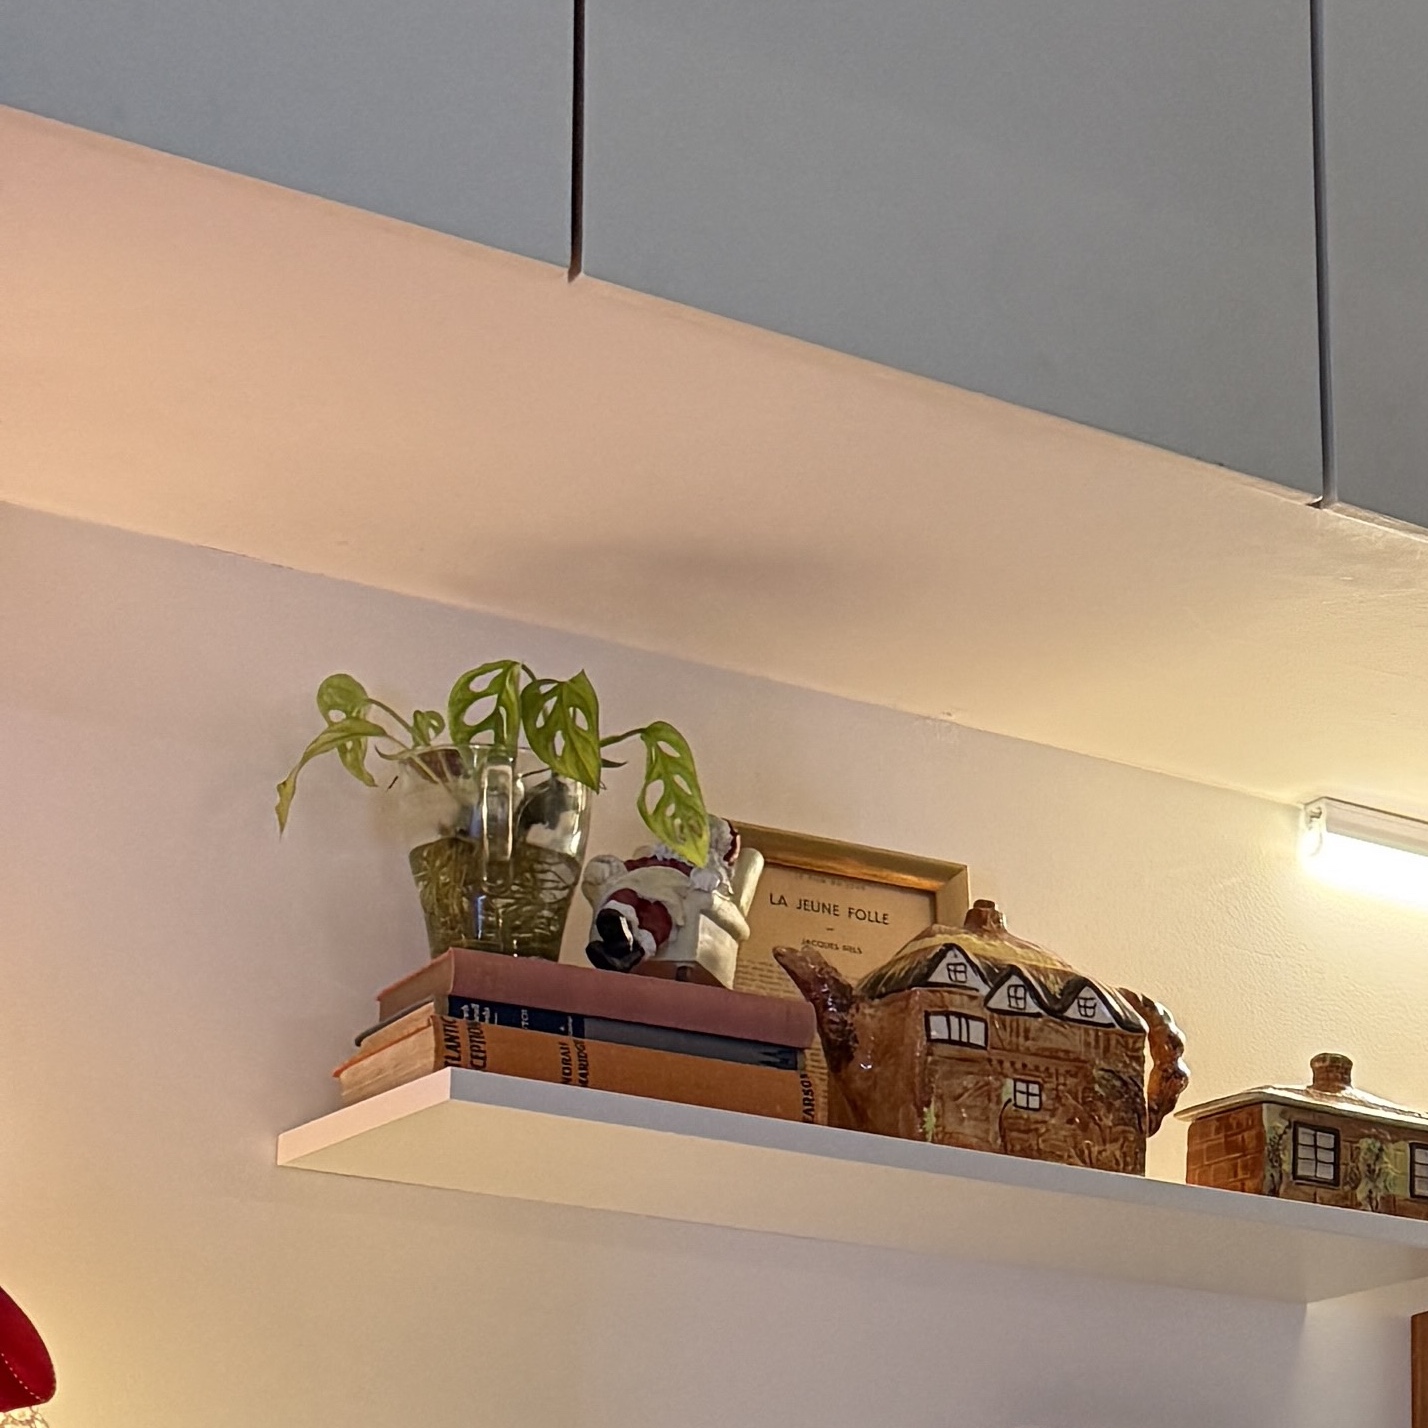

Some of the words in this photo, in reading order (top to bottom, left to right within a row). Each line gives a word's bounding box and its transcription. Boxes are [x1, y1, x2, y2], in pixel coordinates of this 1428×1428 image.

[770, 893, 789, 908] LA
[796, 898, 840, 917] JEUNE
[848, 907, 890, 926] FOLLE
